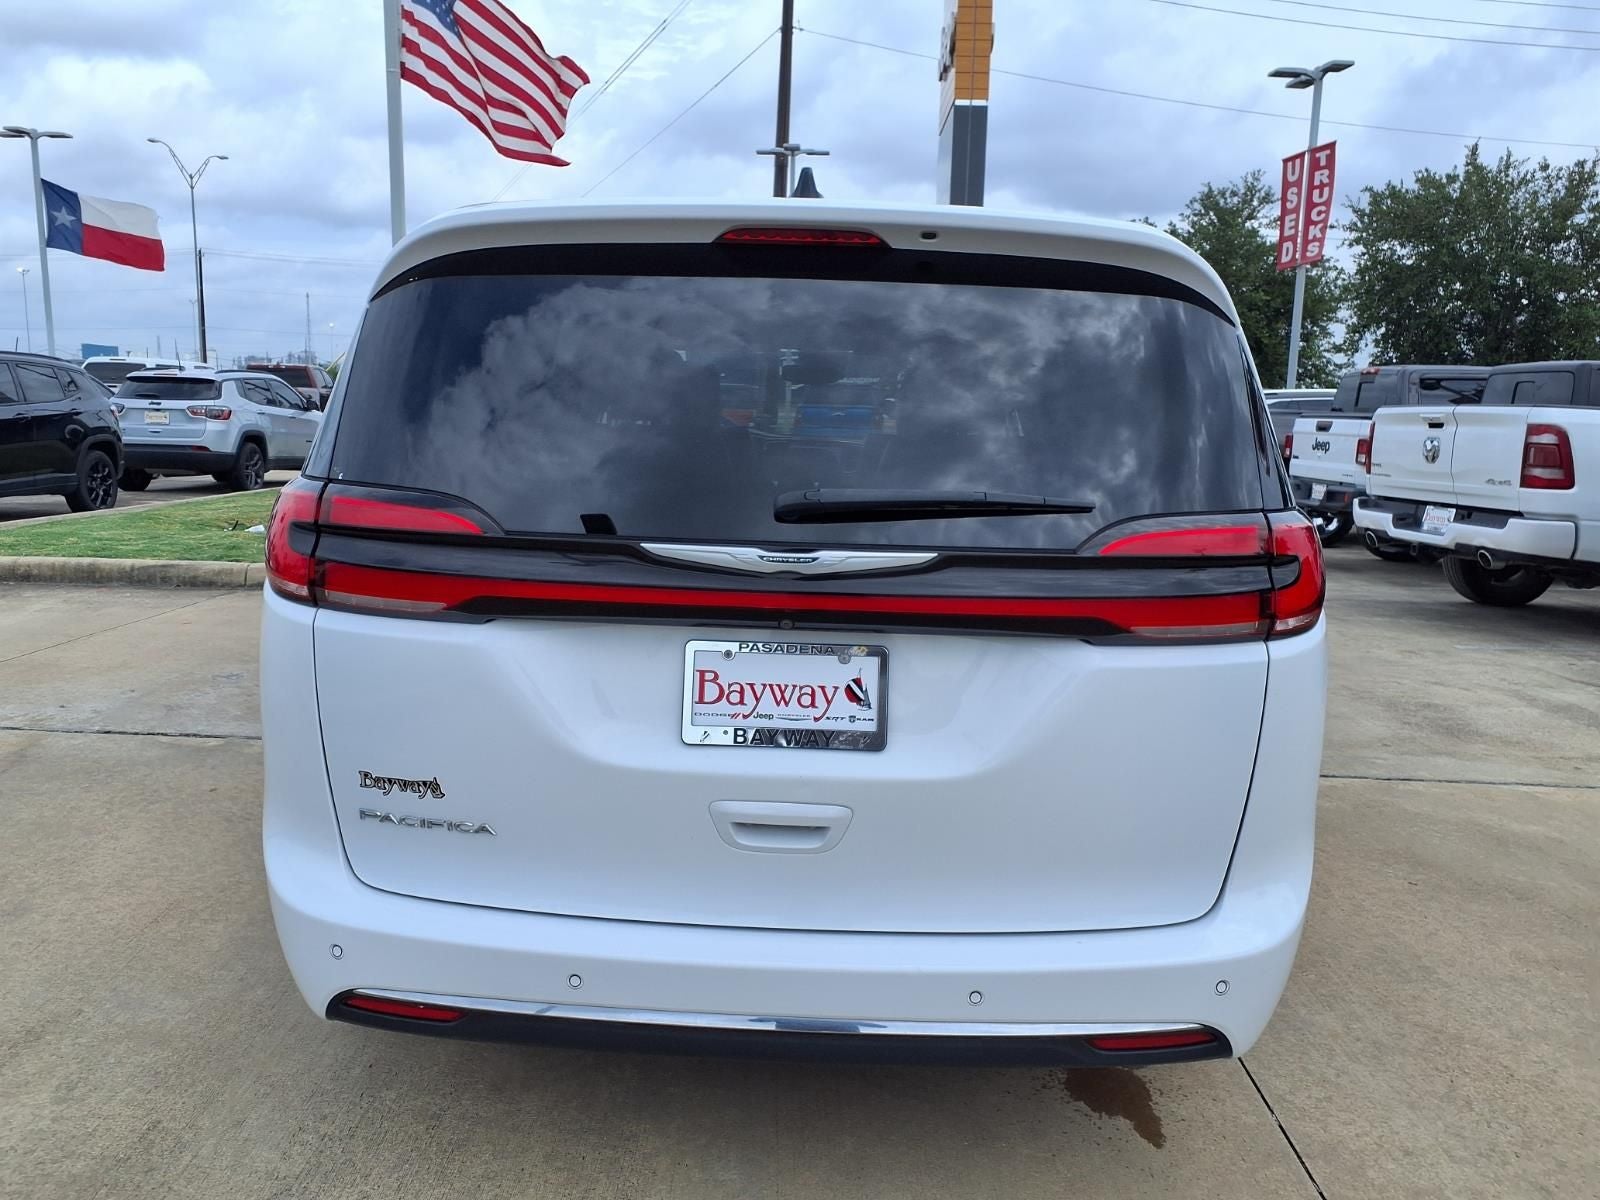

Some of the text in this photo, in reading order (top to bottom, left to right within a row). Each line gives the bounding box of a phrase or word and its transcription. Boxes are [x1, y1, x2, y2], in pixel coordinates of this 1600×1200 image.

[1281, 158, 1301, 263] USED
[1305, 149, 1331, 257] TRUCKS
[1311, 437, 1331, 454] Jeep
[738, 643, 836, 656] PASADENA
[694, 669, 840, 722] Bayway
[753, 711, 774, 721] Jeep
[733, 727, 836, 747] BAYWAY
[358, 770, 431, 799] Bayway
[359, 808, 497, 836] PACIFICA
